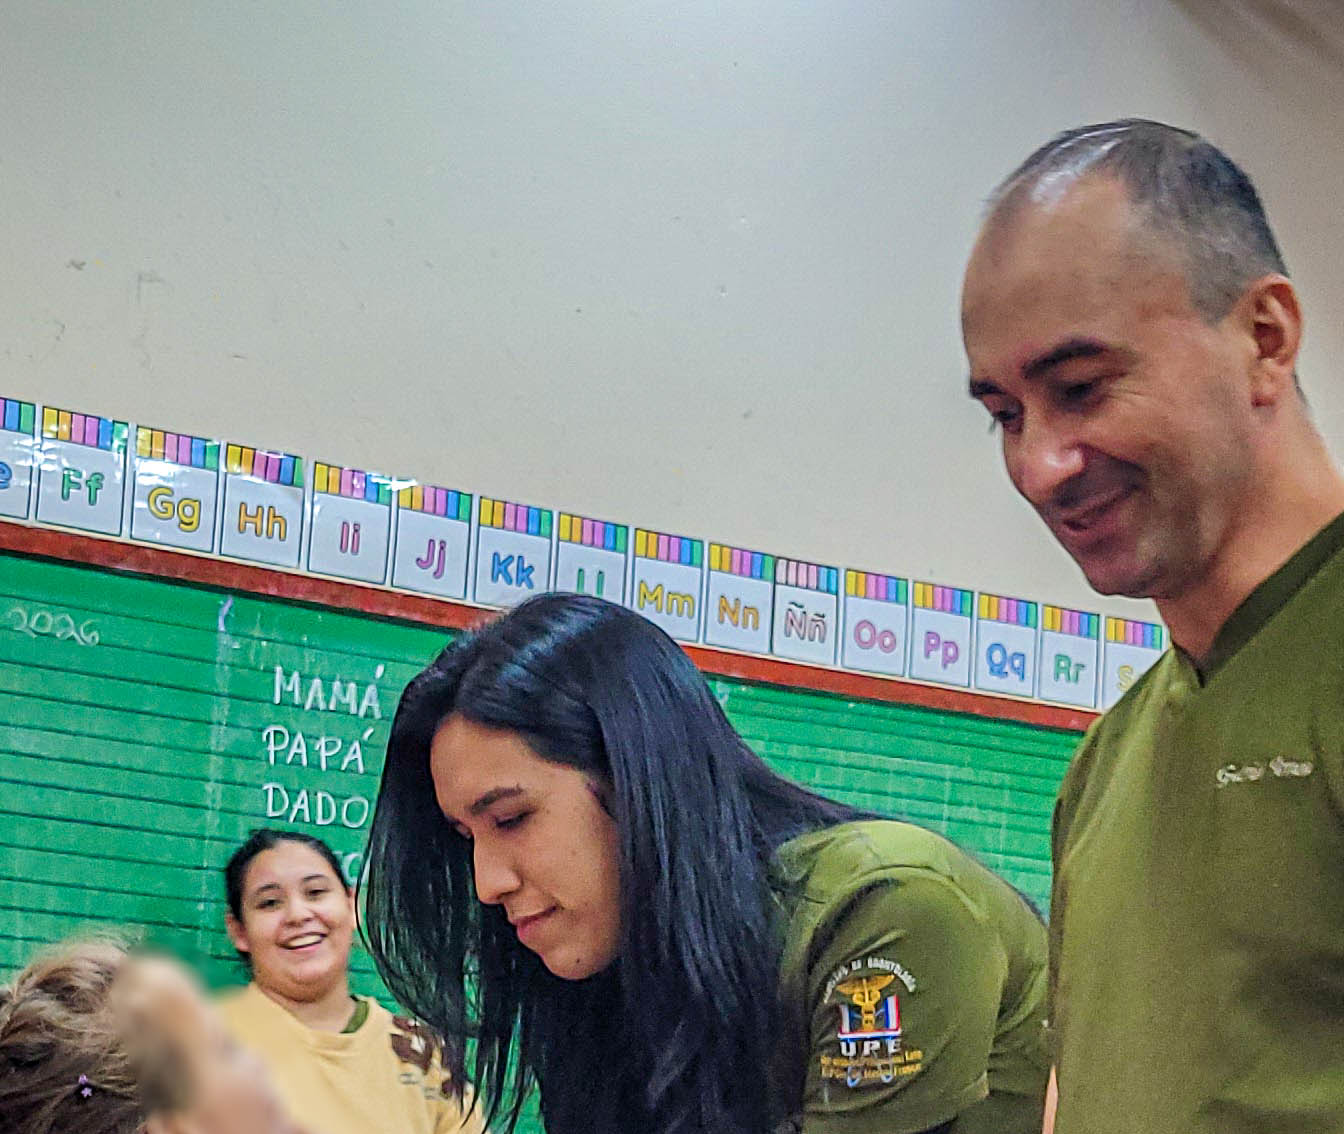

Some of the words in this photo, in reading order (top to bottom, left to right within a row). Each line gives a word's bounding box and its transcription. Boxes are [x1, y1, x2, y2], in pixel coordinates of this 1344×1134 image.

[61, 467, 105, 505] Ff
[148, 487, 201, 532] Gg
[238, 502, 287, 541] Hh
[416, 538, 447, 579] Jj
[491, 552, 535, 589] Kk
[638, 579, 695, 618] Mm
[718, 595, 760, 631] Nn
[784, 602, 828, 643] Ññ
[854, 620, 897, 654] Oo
[923, 631, 959, 669] Pp
[986, 643, 1026, 682] Qq
[1053, 654, 1086, 683] Rr
[8, 606, 100, 647] 2026
[272, 664, 385, 720] MAMÁ
[261, 724, 374, 774] PAPÁ
[262, 782, 370, 828] DADO
[839, 1037, 902, 1057] UPE
